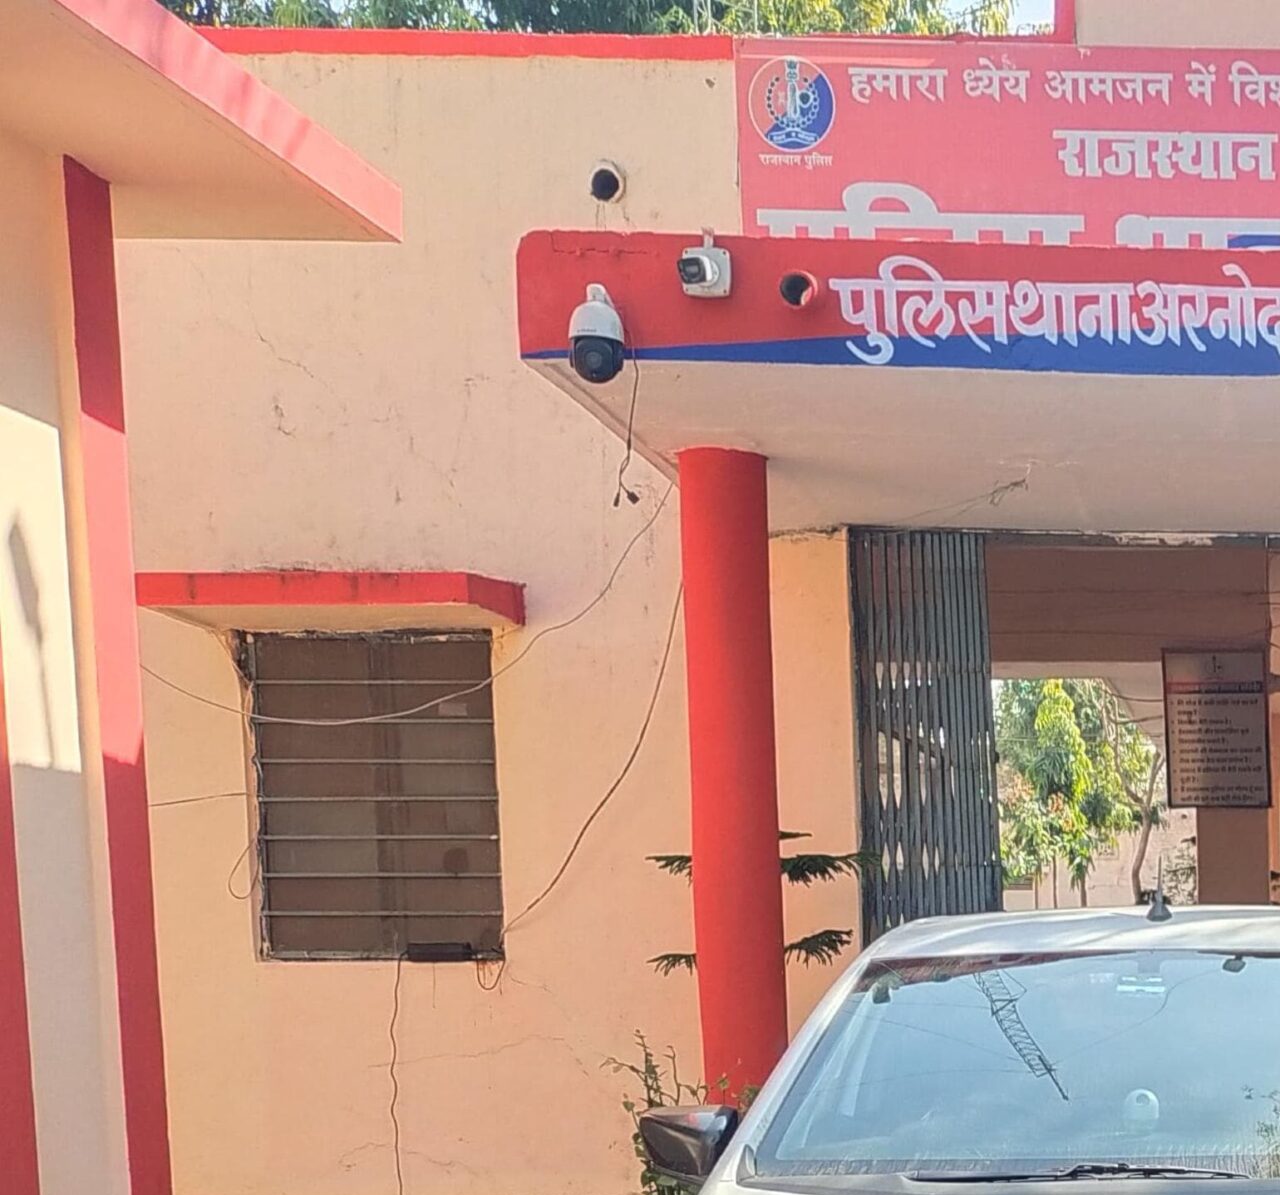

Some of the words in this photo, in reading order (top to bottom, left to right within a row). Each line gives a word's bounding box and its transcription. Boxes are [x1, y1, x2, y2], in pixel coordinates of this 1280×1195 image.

[848, 68, 948, 103] हमारा
[962, 57, 1030, 103] ध्येय
[1044, 70, 1173, 106] आमजन
[1185, 61, 1216, 107] में
[1053, 129, 1278, 181] राजस्थान
[828, 255, 1010, 365] पुलिस
[1009, 280, 1135, 348] थाना
